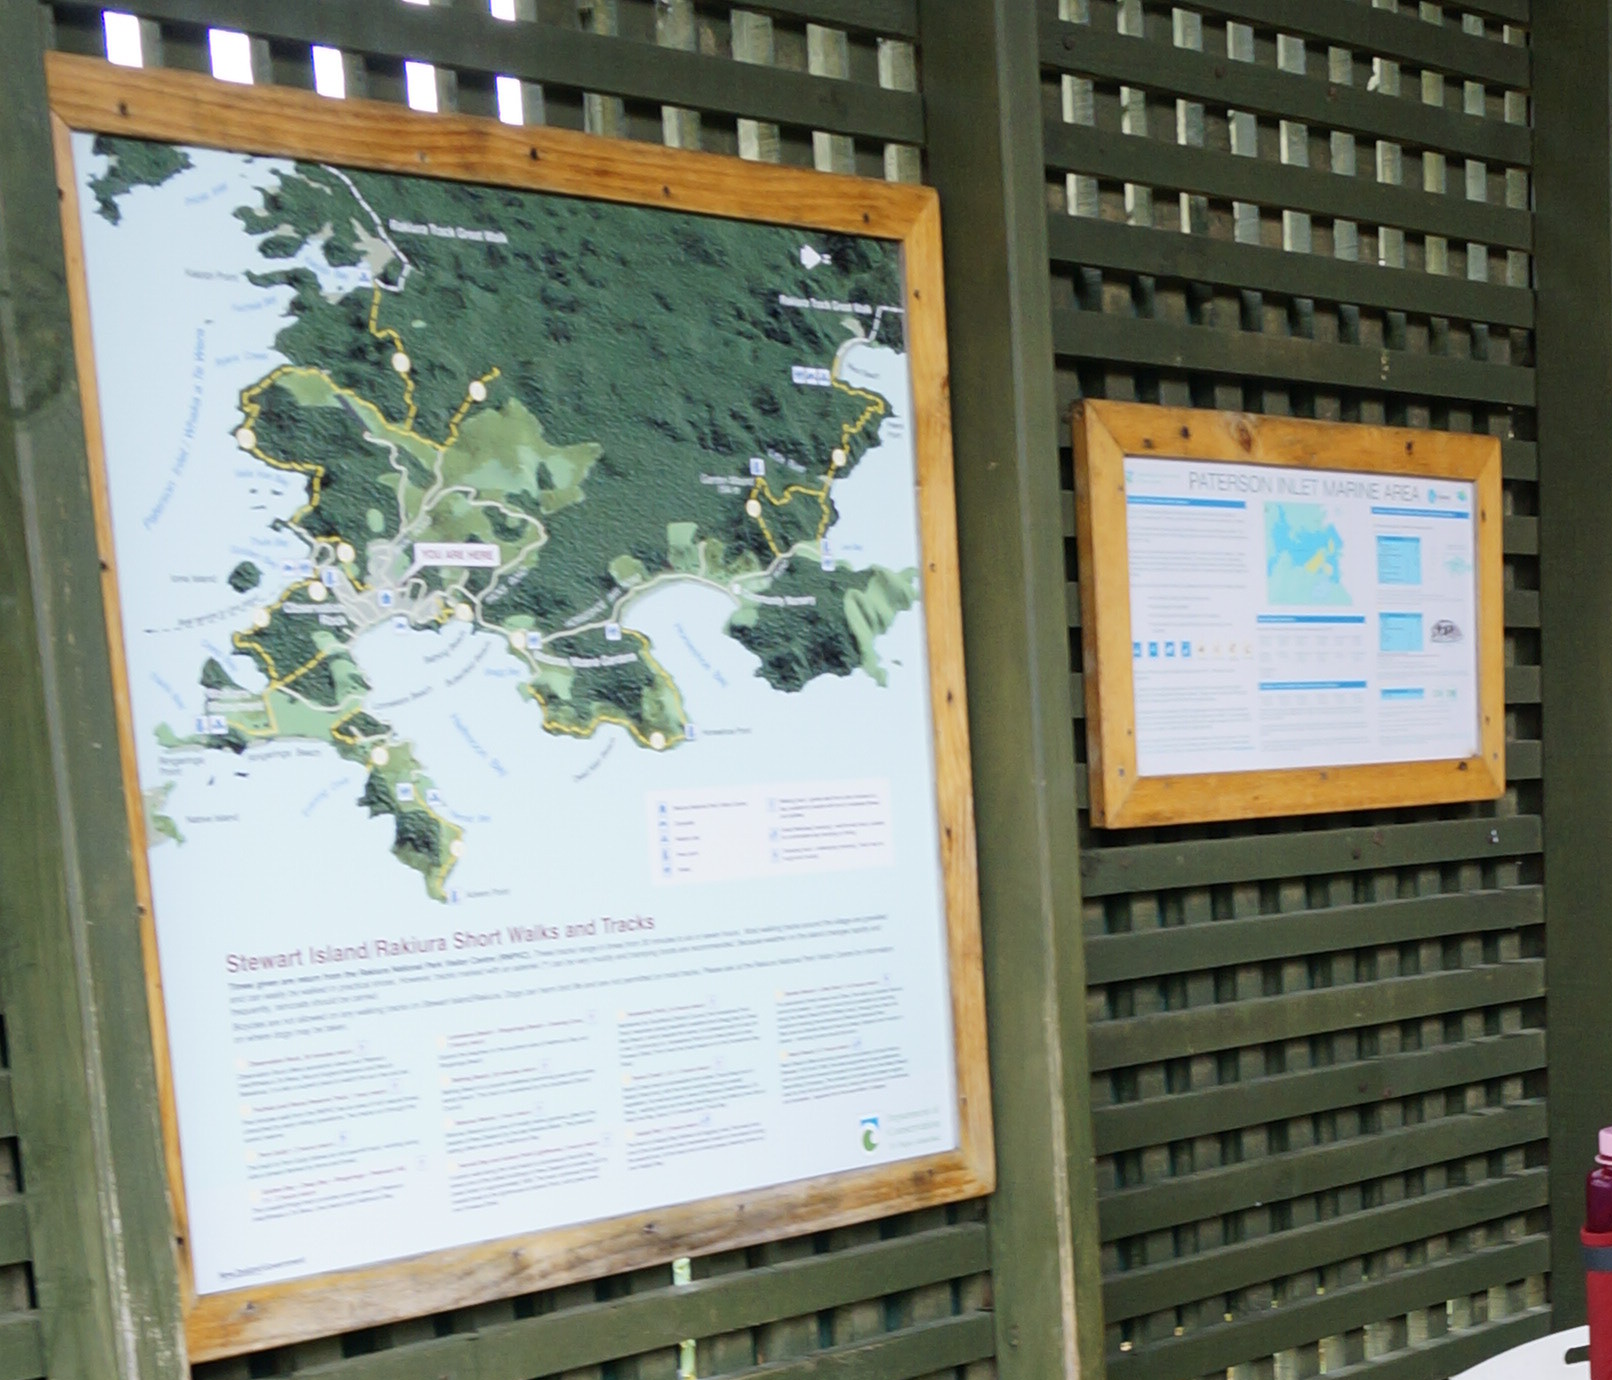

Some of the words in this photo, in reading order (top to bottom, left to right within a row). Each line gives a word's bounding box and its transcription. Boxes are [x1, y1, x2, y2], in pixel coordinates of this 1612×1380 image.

[1188, 471, 1272, 495] PATERSON
[1277, 476, 1319, 497] INLET
[1323, 479, 1380, 500] MARINE
[1384, 483, 1420, 503] AREA
[226, 948, 303, 974] Stewart
[309, 941, 369, 966] Island
[374, 935, 447, 959] Rakiura
[453, 929, 502, 950] Short
[507, 922, 560, 944] Walks
[565, 919, 597, 939] and
[601, 914, 656, 934] Tracks
